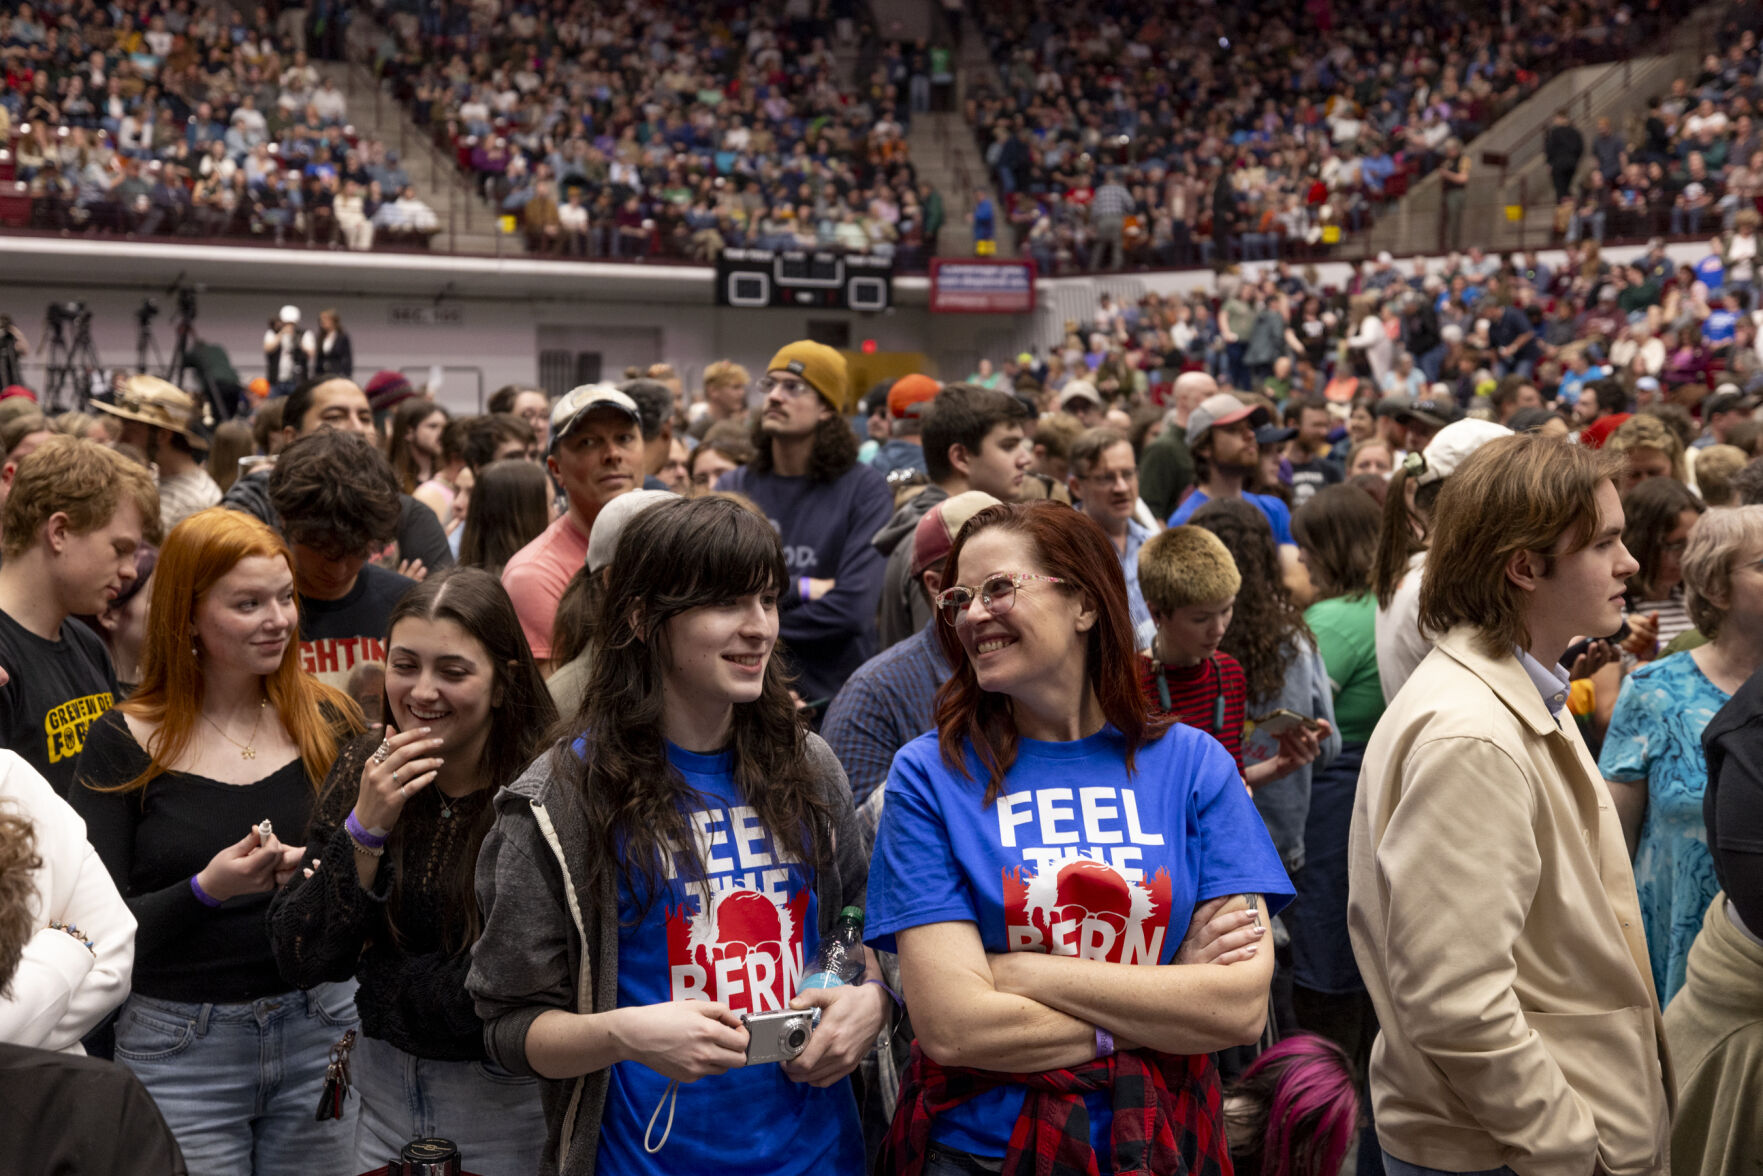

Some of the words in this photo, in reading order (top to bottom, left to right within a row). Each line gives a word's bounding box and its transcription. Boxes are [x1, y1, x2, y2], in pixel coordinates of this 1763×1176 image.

[997, 786, 1165, 847] FEEL
[1022, 846, 1144, 882] THE
[1007, 917, 1166, 966] BERN
[670, 941, 804, 1019] BERN
